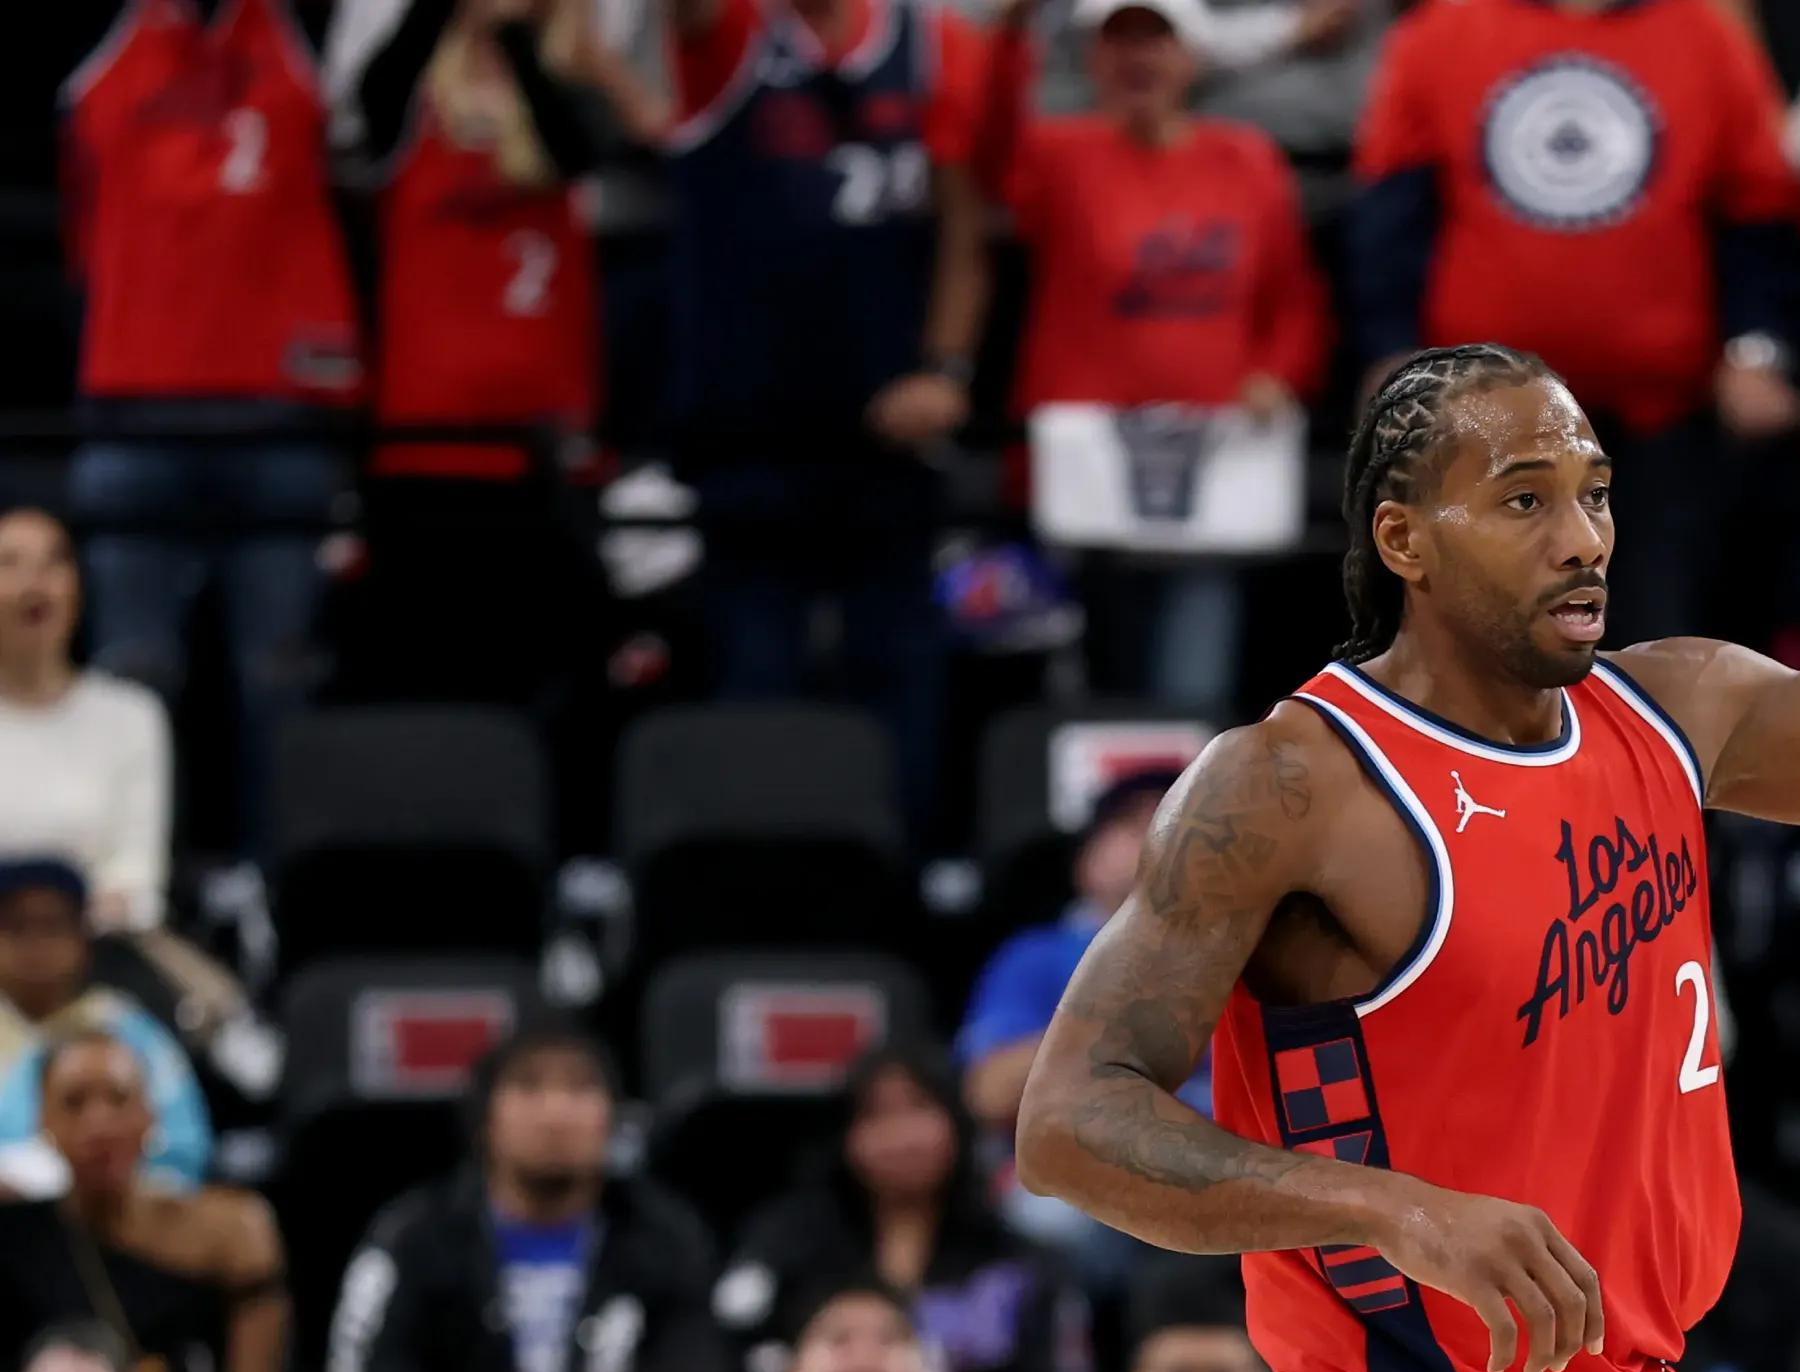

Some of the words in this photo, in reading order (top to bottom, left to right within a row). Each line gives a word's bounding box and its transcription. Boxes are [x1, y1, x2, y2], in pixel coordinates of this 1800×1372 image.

[1555, 815, 1649, 922] Los
[1517, 833, 1697, 1049] Angeles
[1675, 960, 1720, 1094] 2
